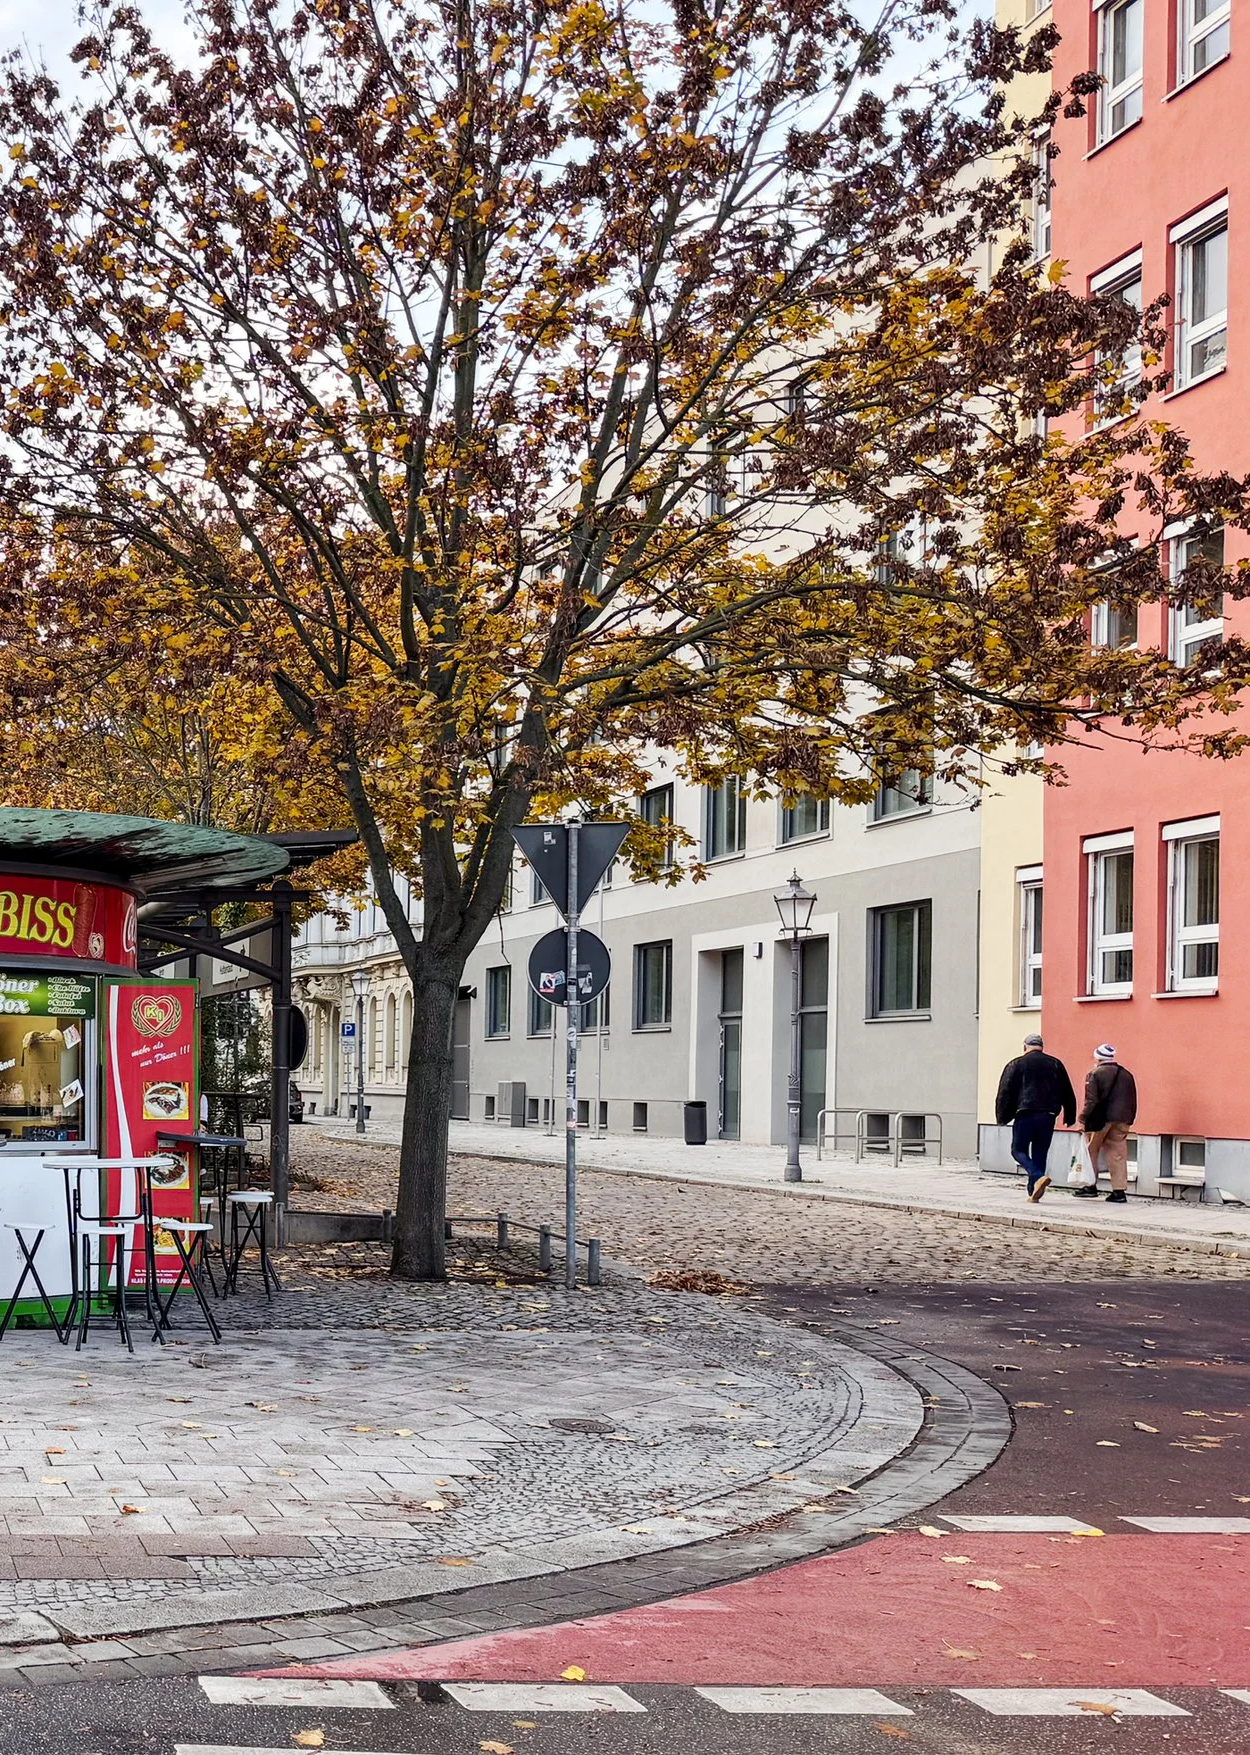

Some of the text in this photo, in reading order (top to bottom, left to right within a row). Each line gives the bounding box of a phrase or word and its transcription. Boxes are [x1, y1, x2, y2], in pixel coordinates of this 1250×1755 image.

[145, 1005, 164, 1022] KI
[152, 1041, 164, 1050] als
[154, 1052, 177, 1063] Döner
